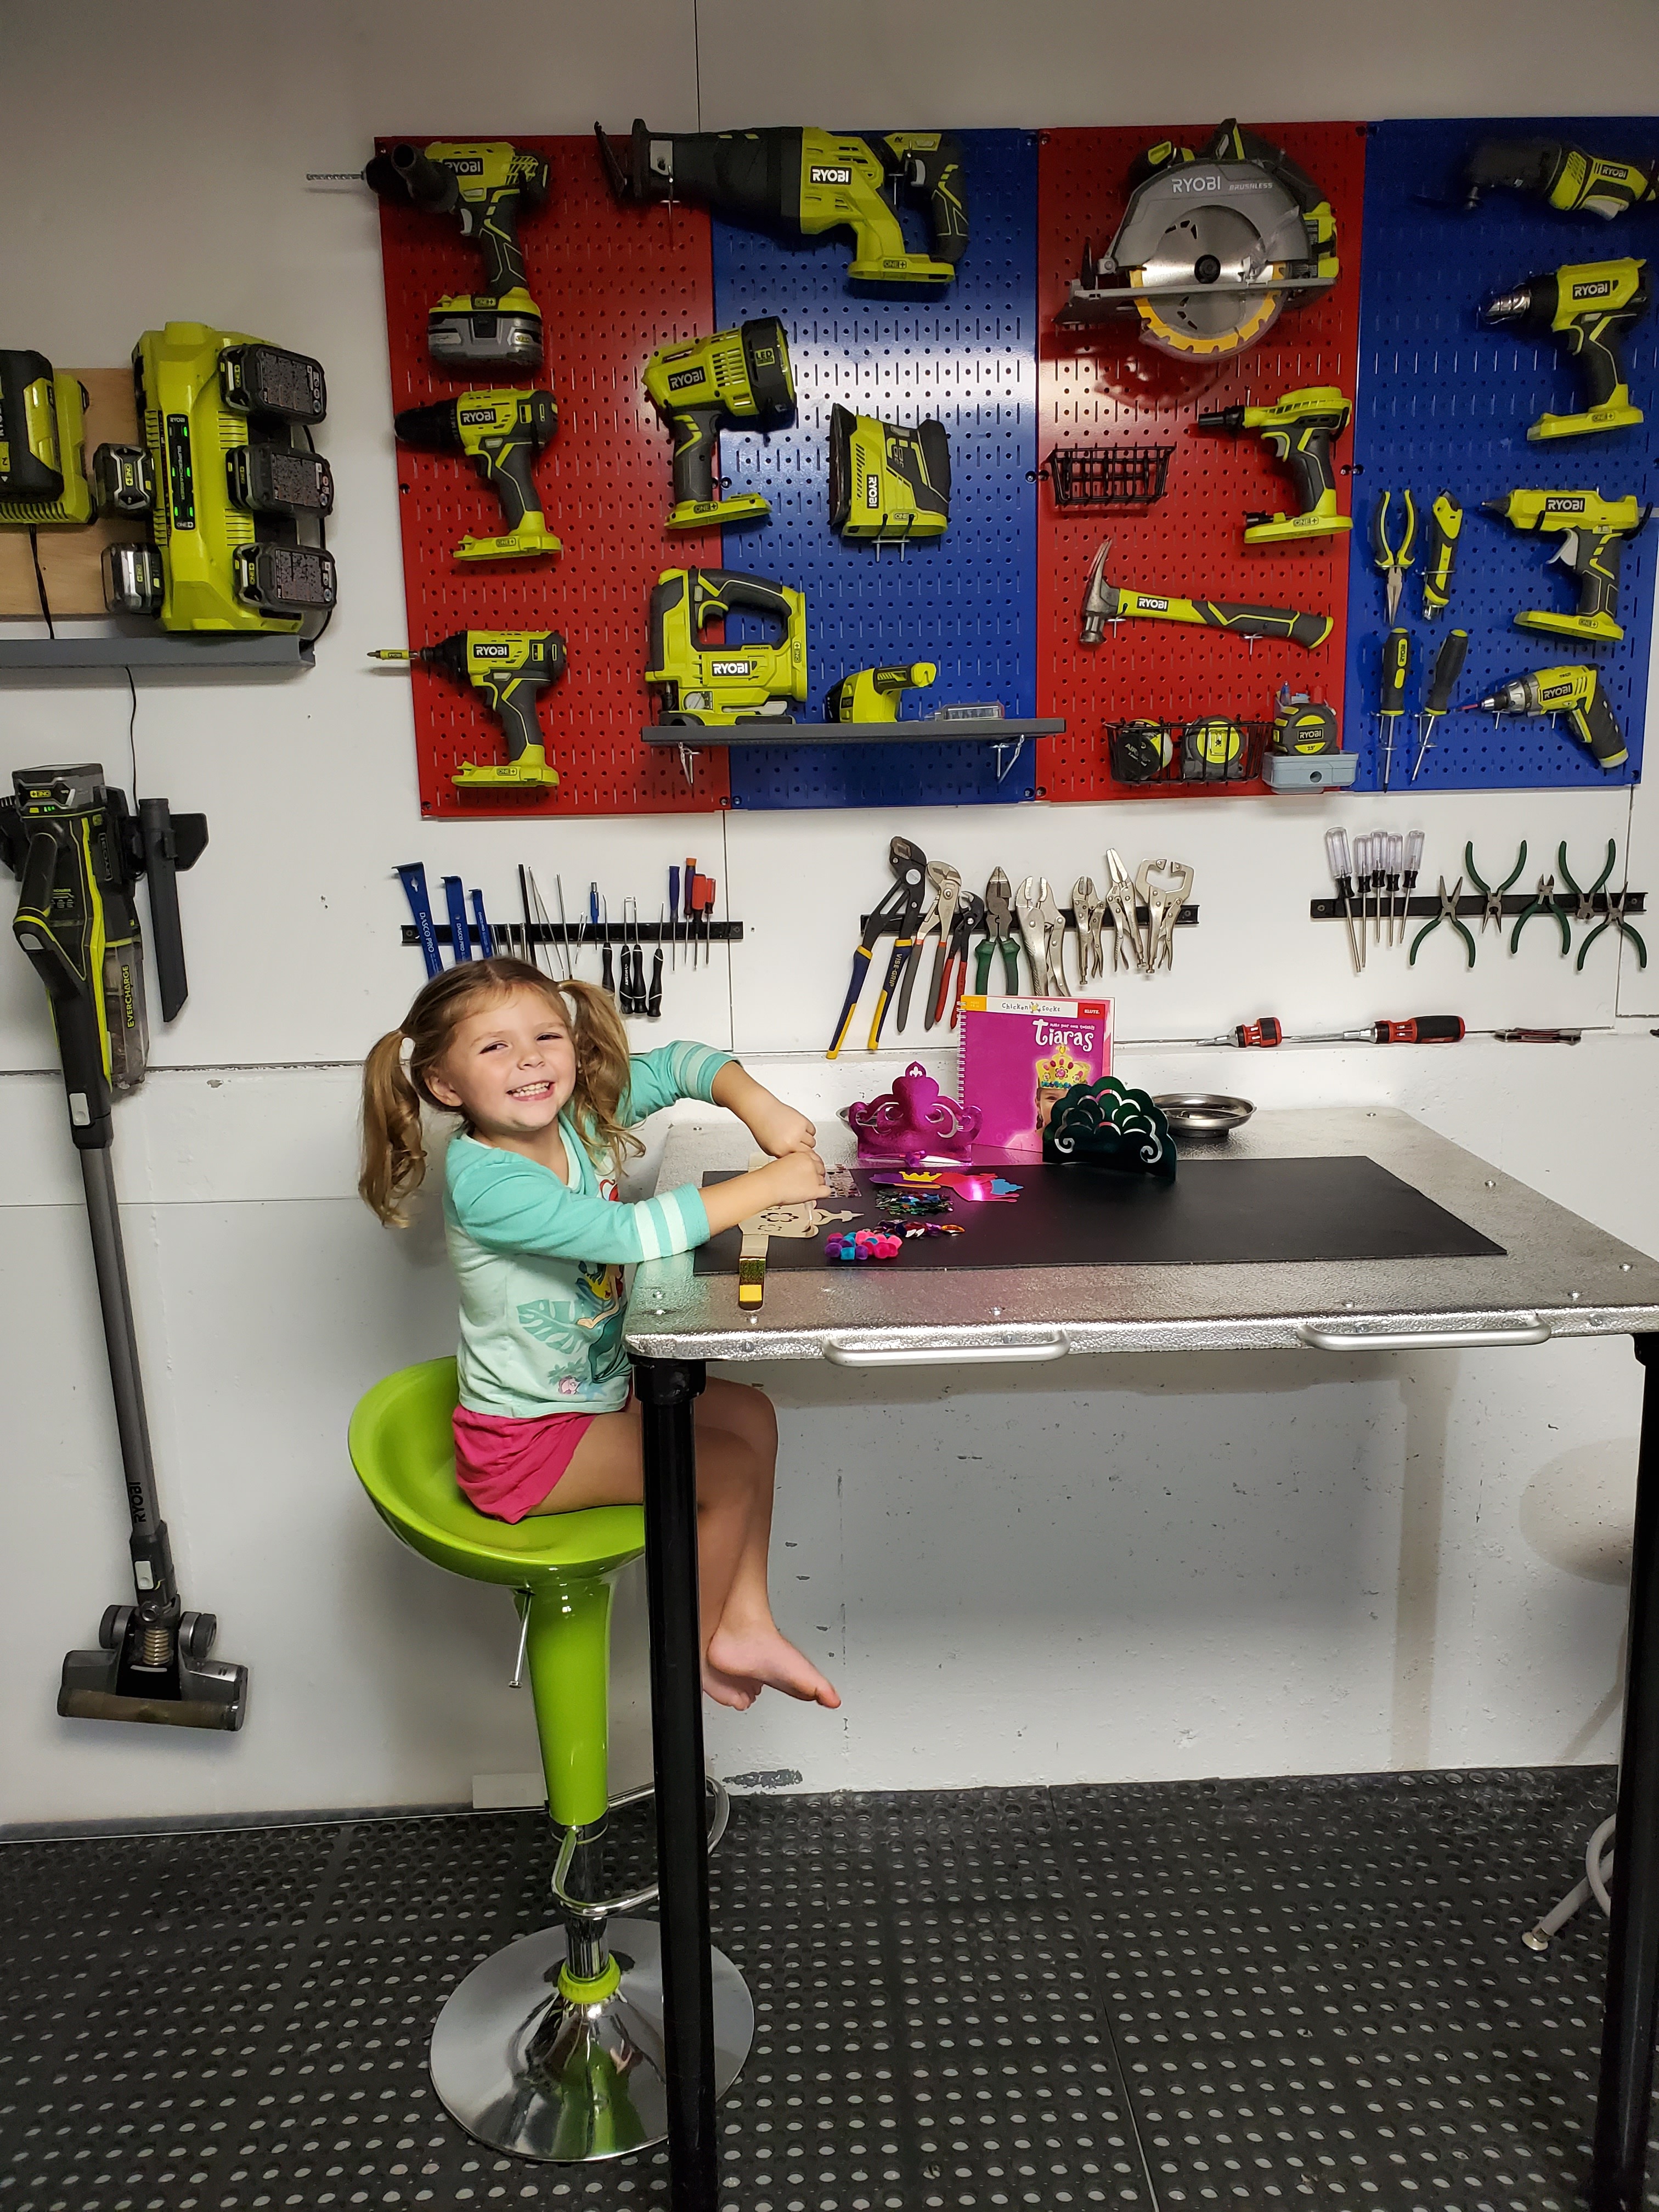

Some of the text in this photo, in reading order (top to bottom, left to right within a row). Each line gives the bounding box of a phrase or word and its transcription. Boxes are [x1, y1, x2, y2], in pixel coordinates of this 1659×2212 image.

[812, 169, 849, 183] RYOBI
[1602, 166, 1627, 178] RYOBI
[1172, 176, 1273, 193] RYOBI BRUSHLESS
[1575, 283, 1607, 296] RYOBI
[756, 351, 772, 359] LED
[670, 370, 703, 388] RYOBI
[462, 411, 494, 422] RYOBI
[868, 476, 877, 507] RYOBI
[1548, 499, 1583, 510] RYOBI
[1139, 598, 1167, 610] RYOBI
[476, 646, 507, 656] RYOBI
[713, 663, 748, 674] RYOBI
[1543, 685, 1571, 699] RYOBI
[1299, 730, 1321, 739] RYOBI
[420, 912, 434, 952] DASCO PRO
[889, 953, 902, 987] VISE-GRIP
[122, 966, 134, 1028] EVERCHARGE
[129, 1482, 146, 1523] RYOBI
